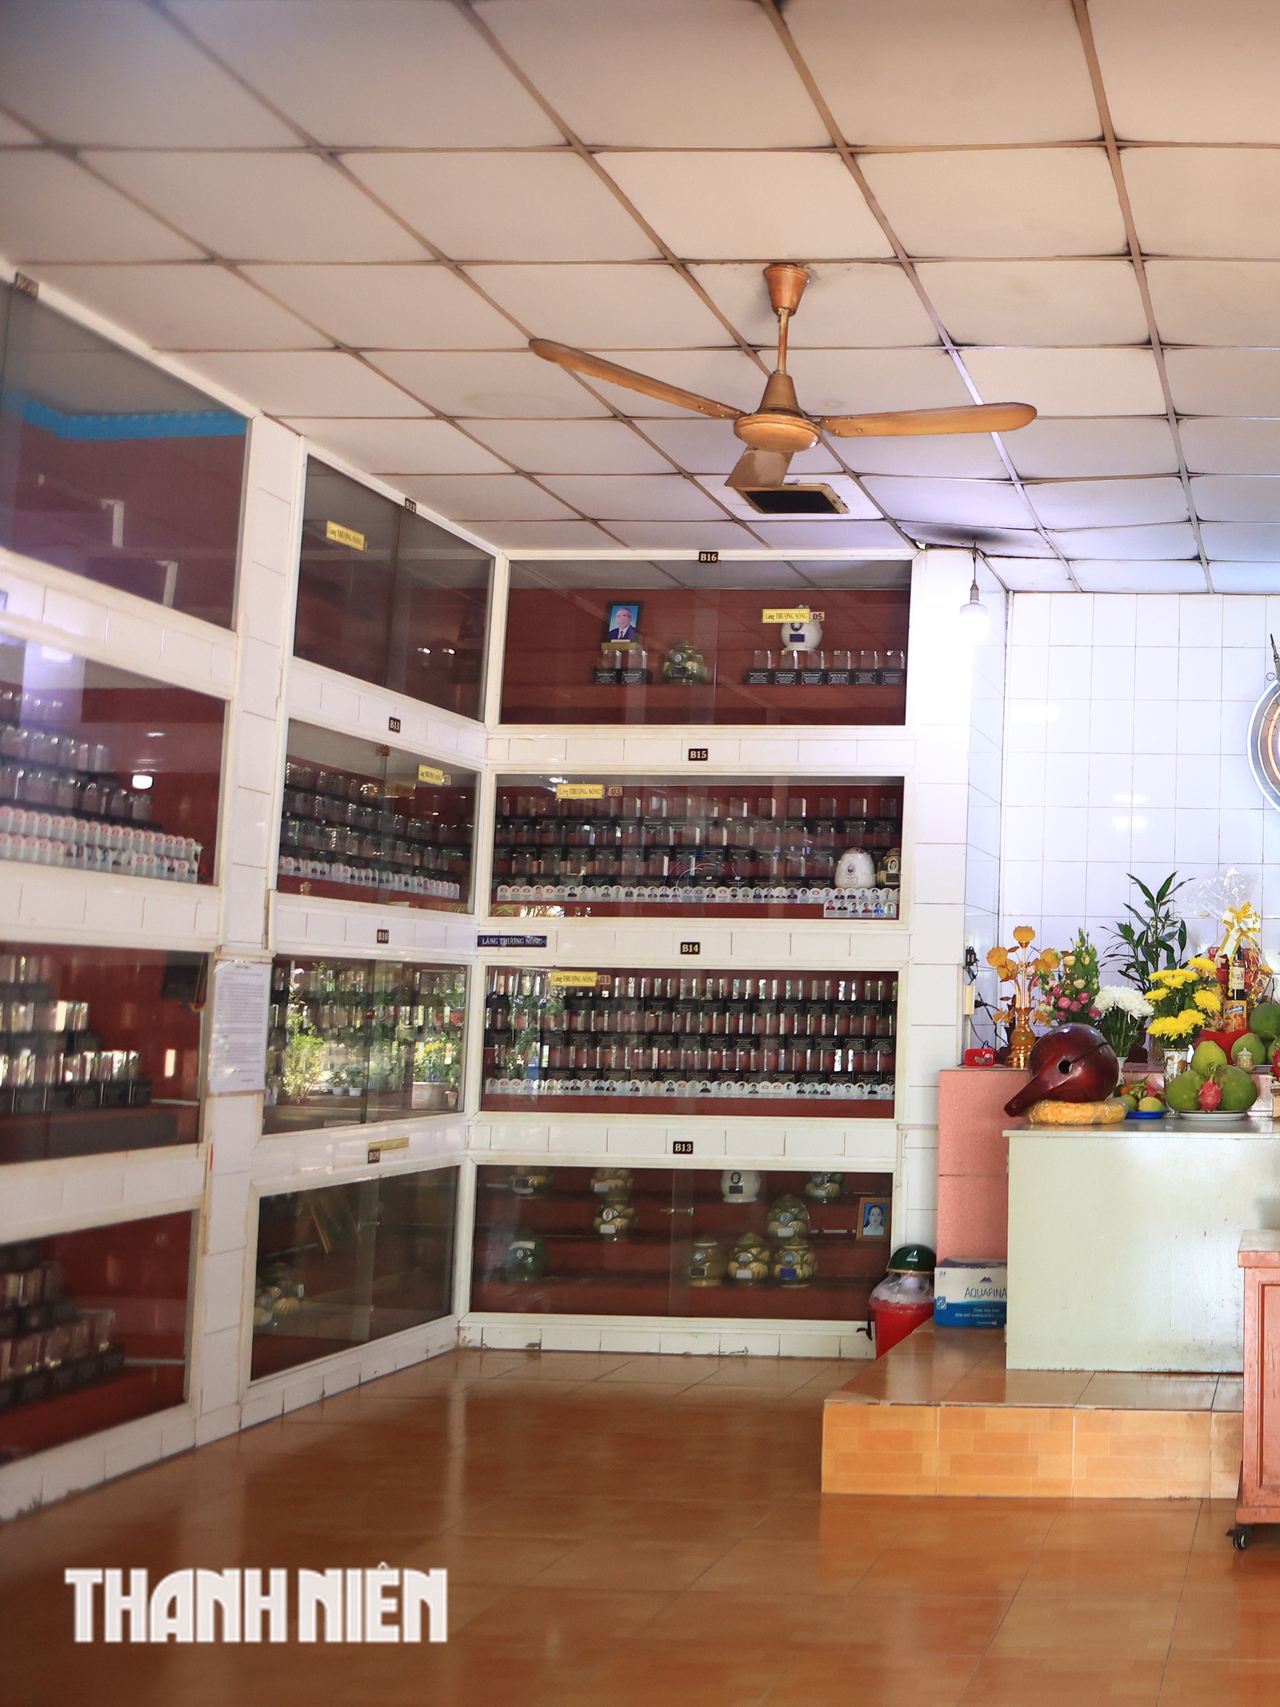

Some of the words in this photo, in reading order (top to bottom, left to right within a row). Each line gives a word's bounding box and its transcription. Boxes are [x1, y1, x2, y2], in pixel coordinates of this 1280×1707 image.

[700, 553, 717, 561] B16
[690, 750, 707, 759] B15
[682, 944, 699, 952] B14
[675, 1143, 692, 1152] B13
